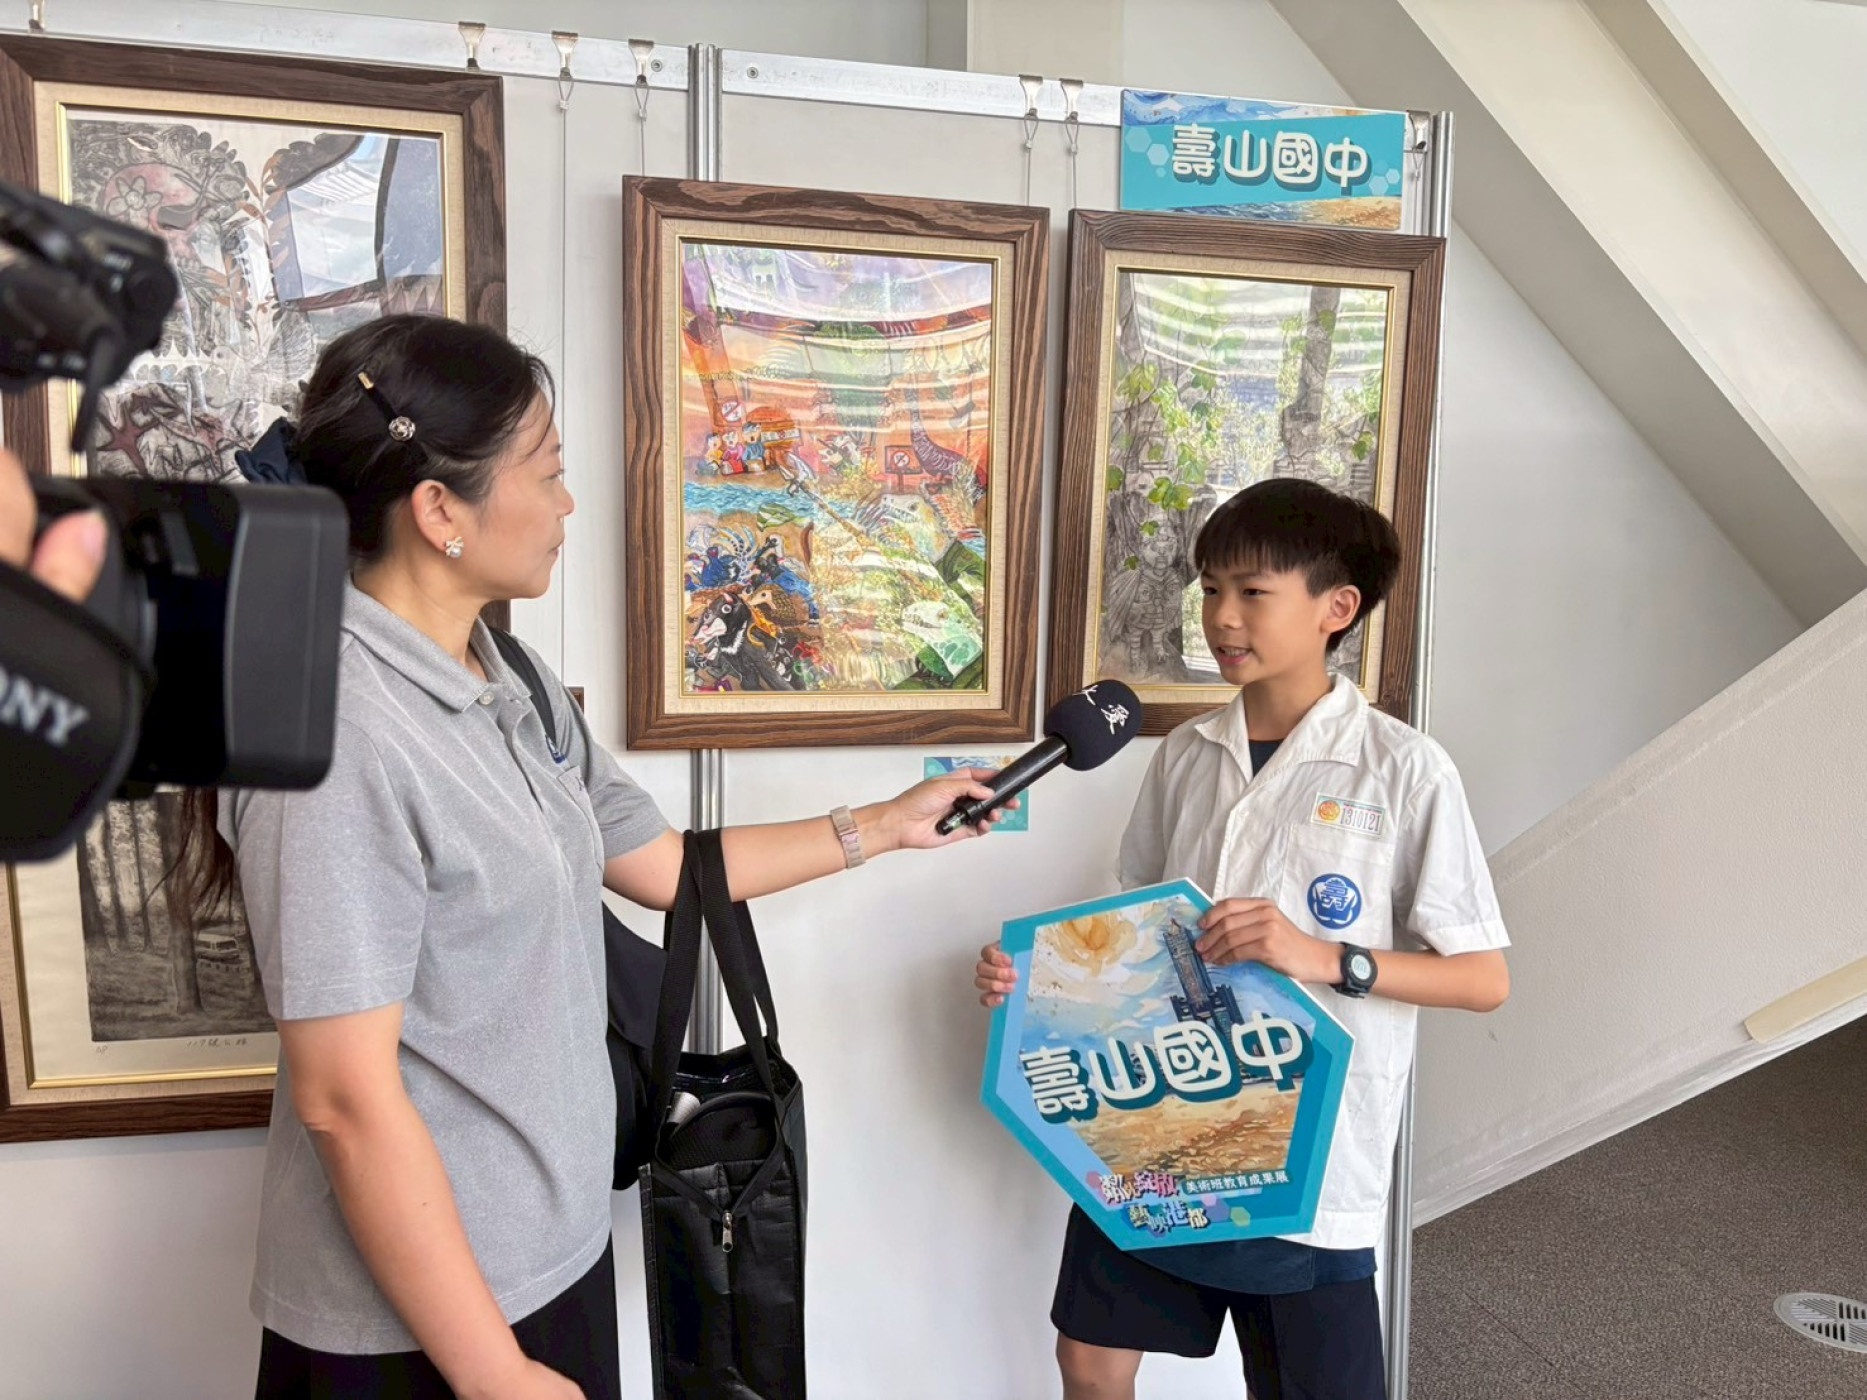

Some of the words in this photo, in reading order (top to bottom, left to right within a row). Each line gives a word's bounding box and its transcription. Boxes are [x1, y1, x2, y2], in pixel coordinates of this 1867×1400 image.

[1172, 122, 1370, 190] 壽山國中
[1019, 1010, 1306, 1116] 壽山國中
[1185, 1169, 1290, 1194] 美術班教育成果展
